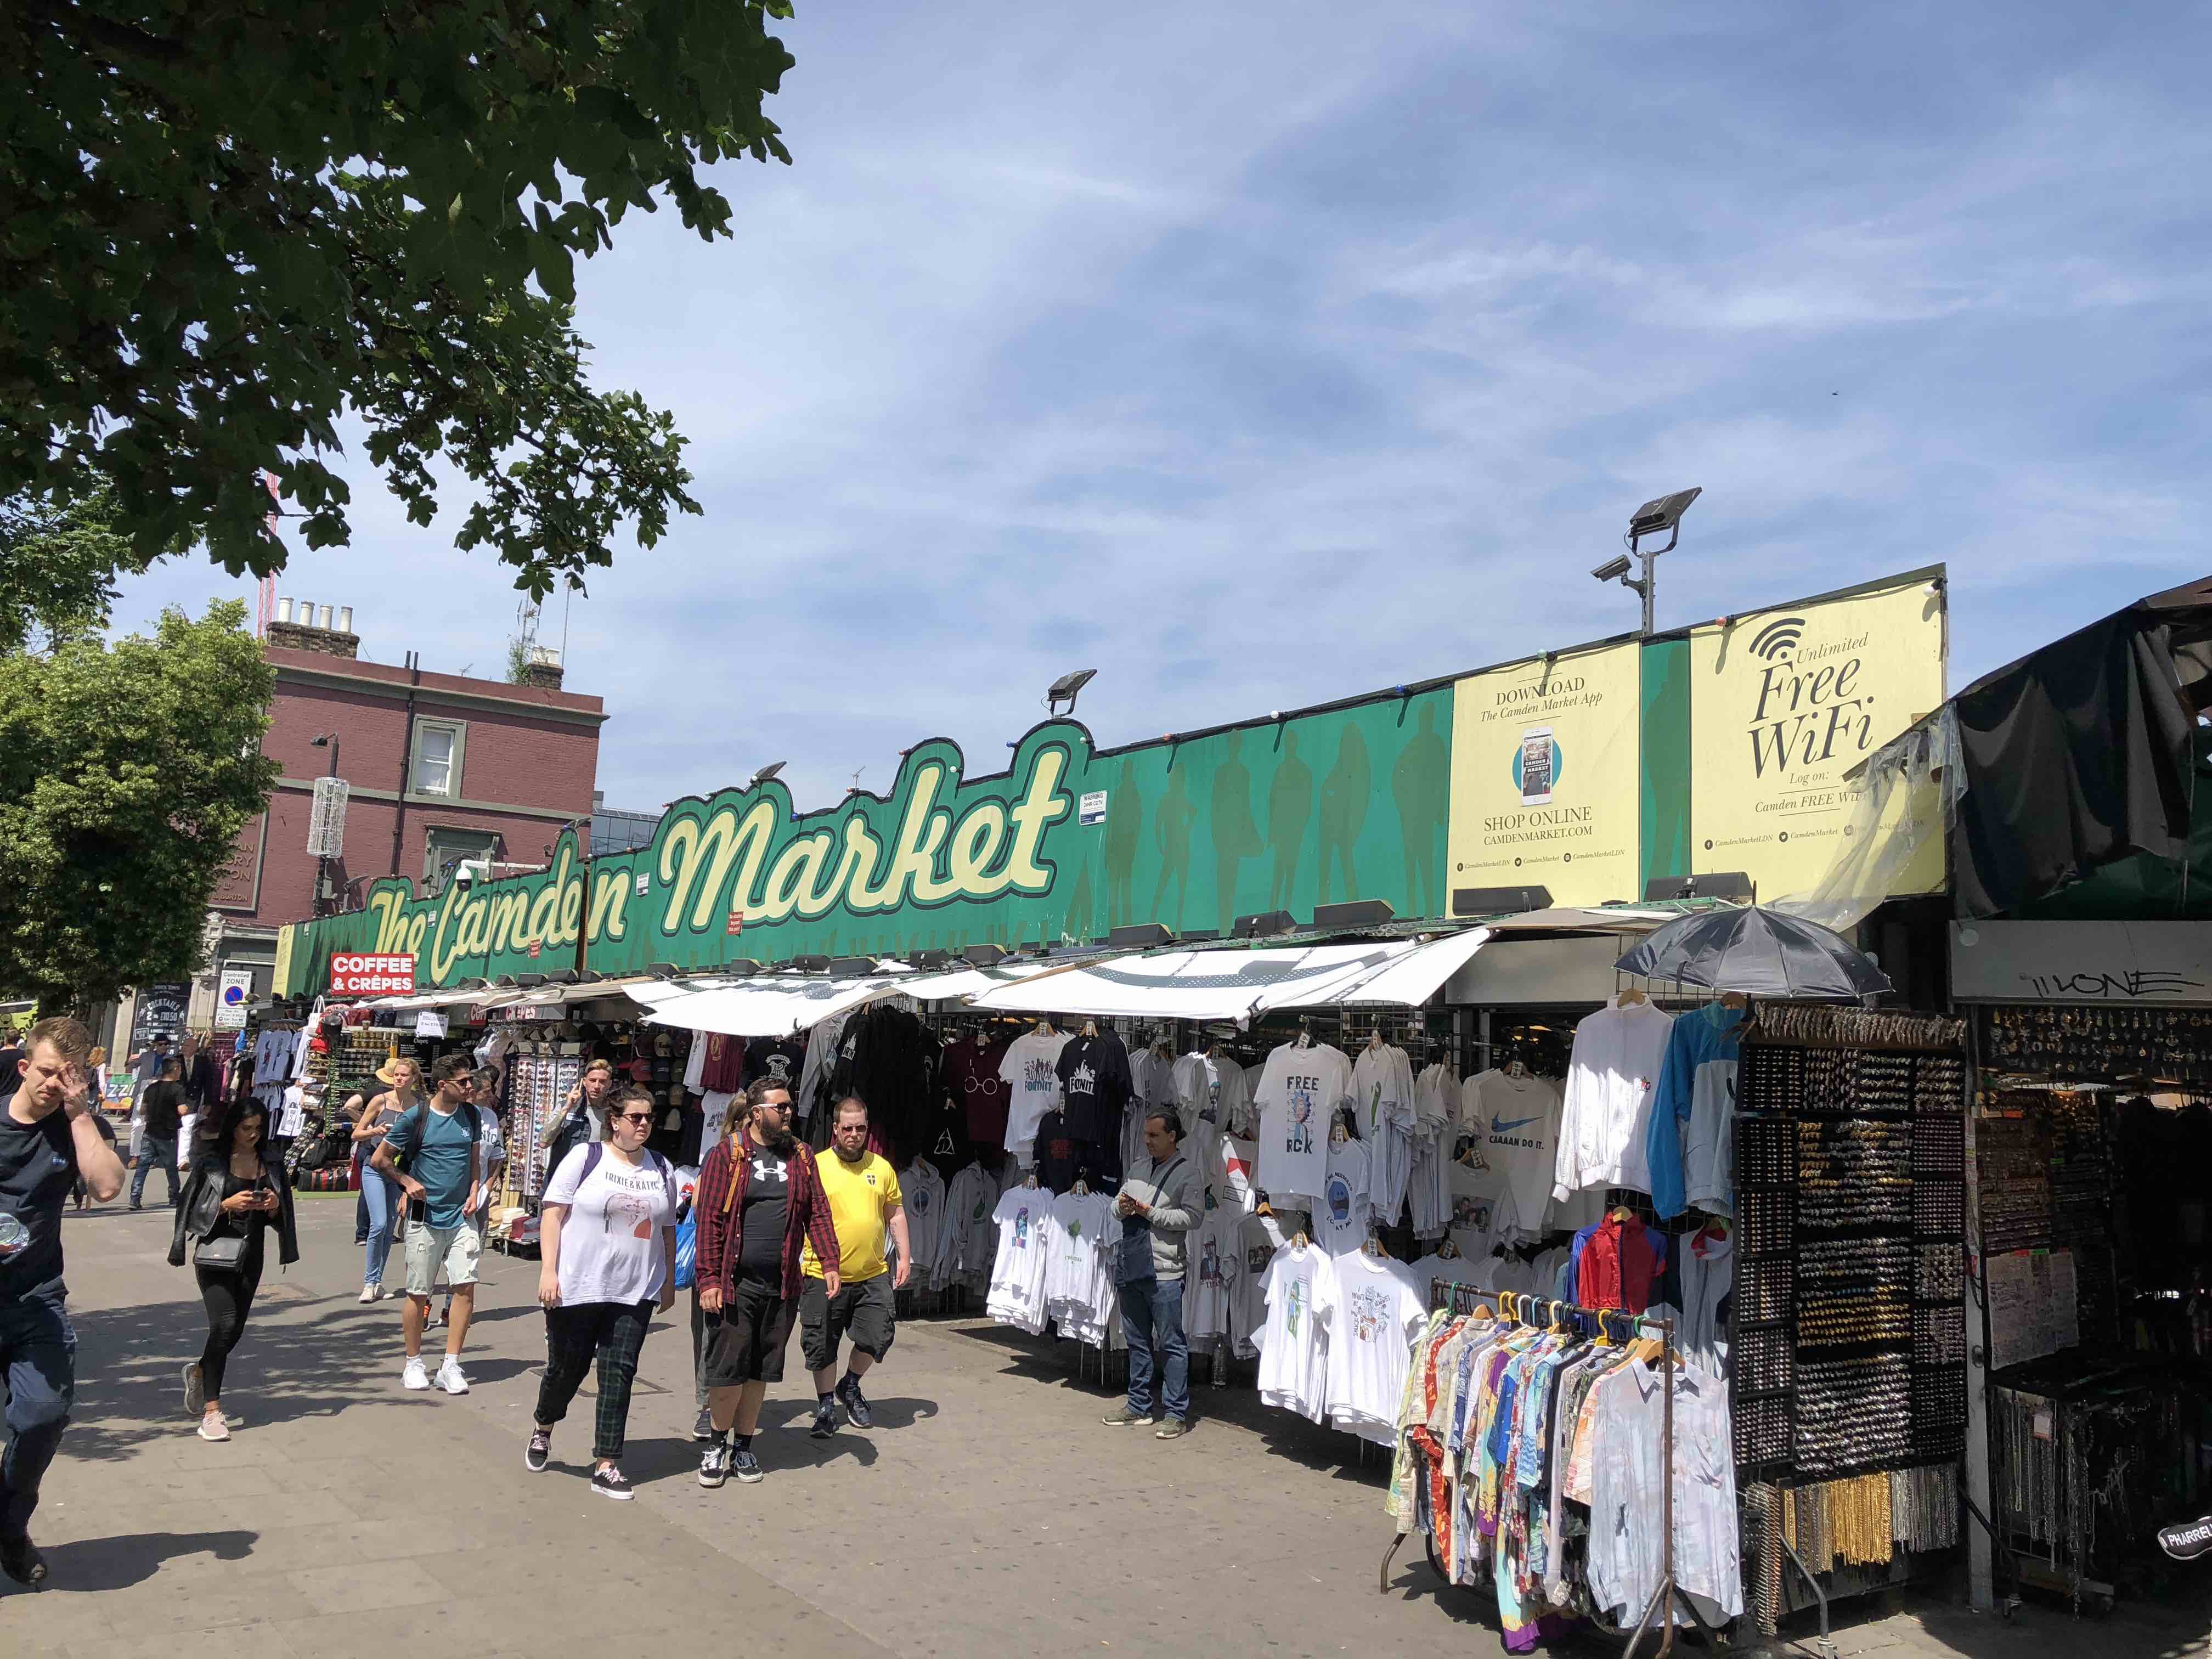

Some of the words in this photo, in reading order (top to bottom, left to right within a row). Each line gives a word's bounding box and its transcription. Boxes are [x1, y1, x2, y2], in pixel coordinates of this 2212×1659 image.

[1797, 631, 1869, 664] Unlimited
[1496, 677, 1585, 706] DOWNLOAD
[1749, 658, 1860, 724] Free
[1481, 710, 1497, 722] The
[1500, 704, 1538, 719] Camden
[1541, 696, 1578, 712] Market
[1581, 692, 1602, 707] App
[1747, 696, 1874, 779] WiFi
[1790, 773, 1809, 786] Log
[1812, 771, 1830, 781] on:
[1755, 800, 1797, 813] Camden
[1801, 793, 1833, 808] FREE
[1484, 814, 1525, 832] SHOP
[1529, 806, 1592, 827] ONLINE
[1483, 825, 1593, 845] CAMDENMARKET.COM
[1715, 834, 1774, 847] CamdenMarketLDN
[1791, 828, 1838, 839] CamdenMarket
[371, 891, 427, 962] The
[661, 752, 1065, 930] Market
[333, 956, 413, 973] COFFEE
[332, 977, 345, 990] &
[348, 974, 413, 990] CRÊPES
[146, 998, 180, 1011] COCKTAILS
[146, 1012, 153, 1020] 2
[1286, 1076, 1319, 1091] FREE
[1522, 1138, 1533, 1148] DO
[1536, 1141, 1544, 1150] IT.
[605, 1171, 628, 1187] TRIXIE
[2167, 1523, 2212, 1547] PHARREL
